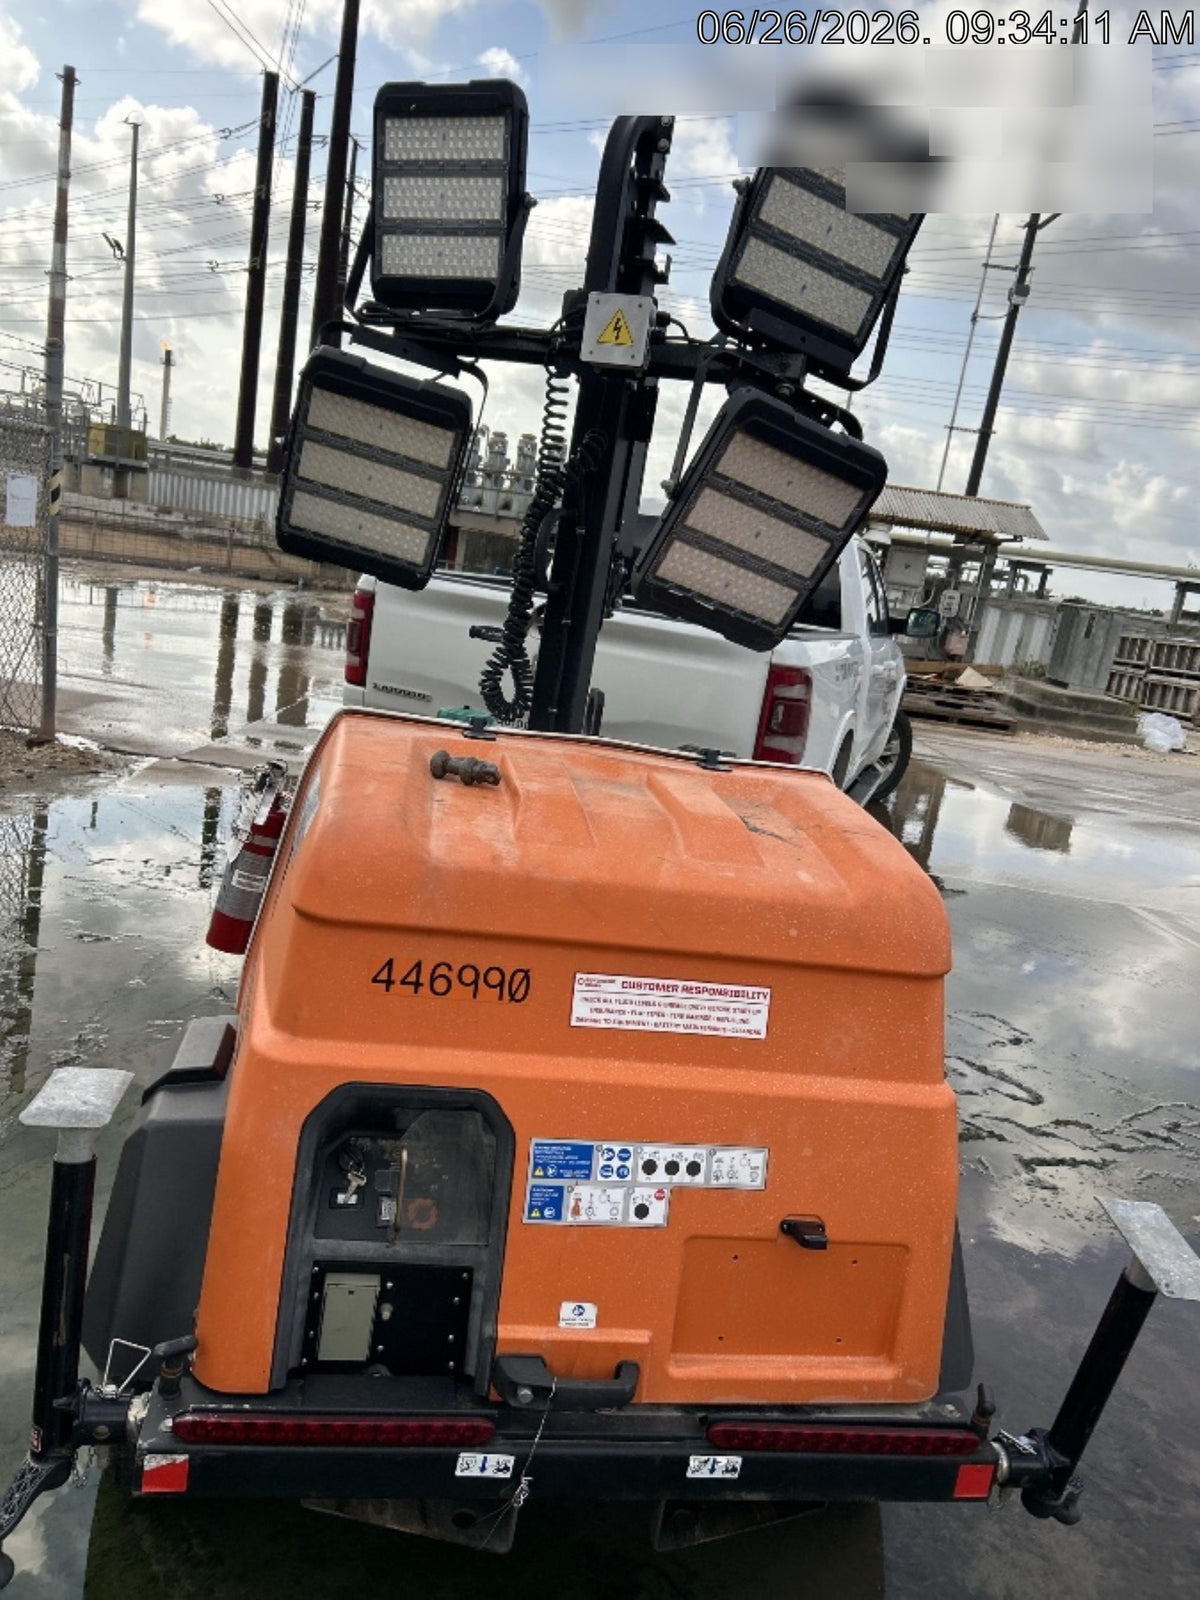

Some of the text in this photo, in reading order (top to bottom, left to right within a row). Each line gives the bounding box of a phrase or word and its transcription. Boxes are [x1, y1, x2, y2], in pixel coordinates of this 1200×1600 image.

[371, 957, 530, 1003] 446990
[621, 980, 679, 993] CUSTOMER
[681, 984, 769, 1000] RESPONSIBILITY
